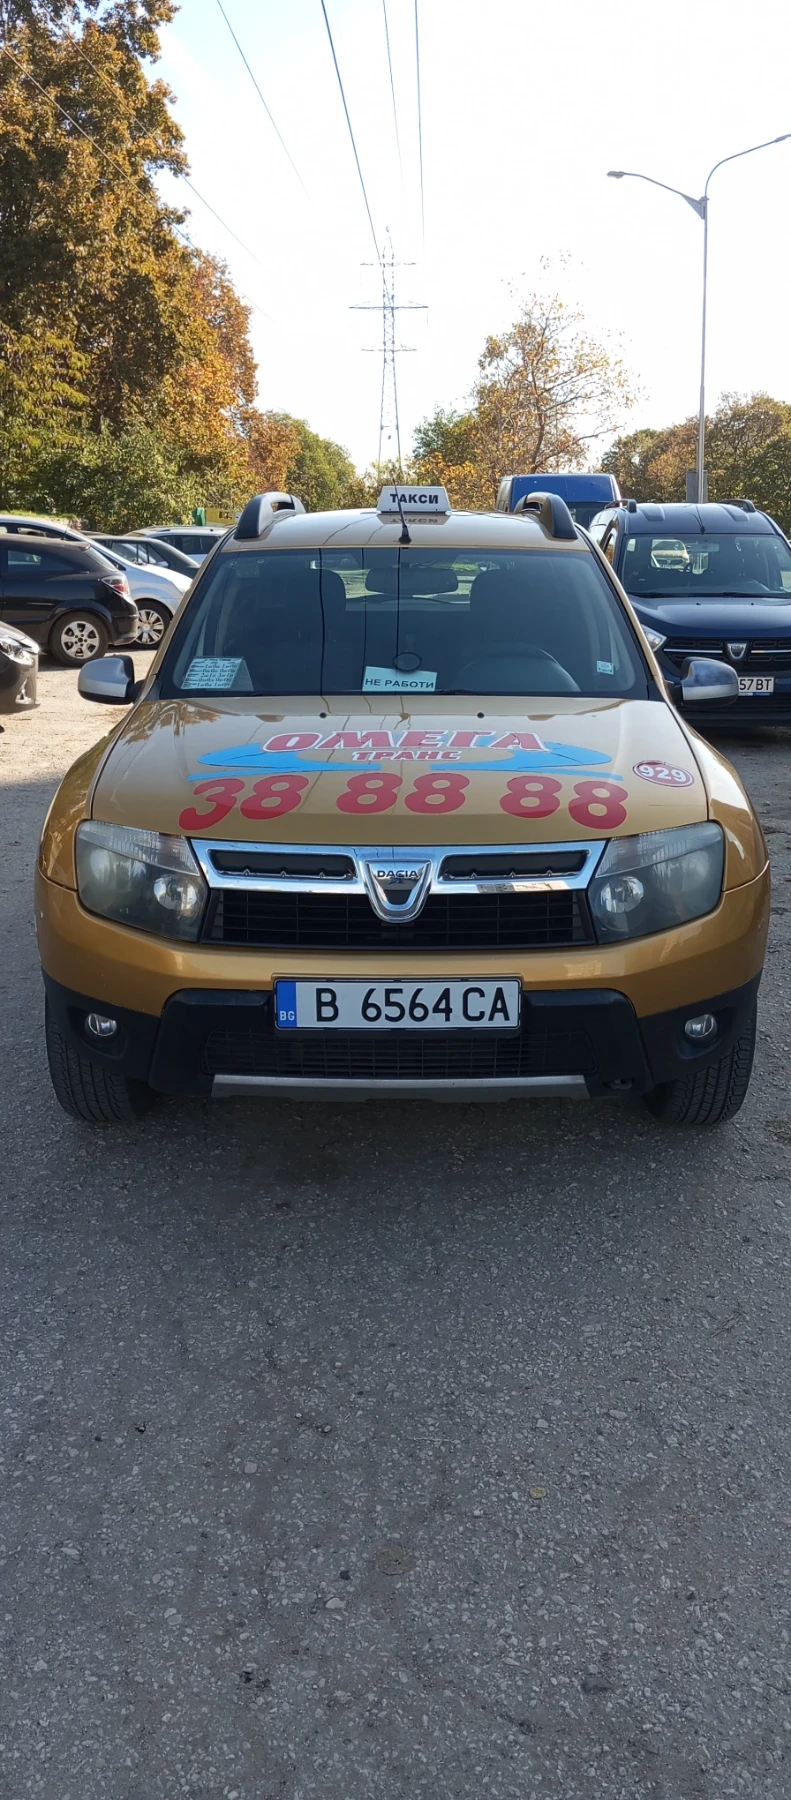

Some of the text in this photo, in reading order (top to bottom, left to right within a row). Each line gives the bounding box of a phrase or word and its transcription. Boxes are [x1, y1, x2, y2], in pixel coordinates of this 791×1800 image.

[390, 494, 438, 504] ТАКСИ
[365, 678, 434, 689] НЕ РАБОТИ
[262, 730, 550, 753] ОМЕГА
[352, 750, 462, 761] ТРАНС
[640, 764, 687, 783] 929
[178, 772, 628, 831] 38 88 88
[377, 870, 419, 878] DACIA
[315, 987, 339, 1022] B
[279, 1011, 295, 1021] BG
